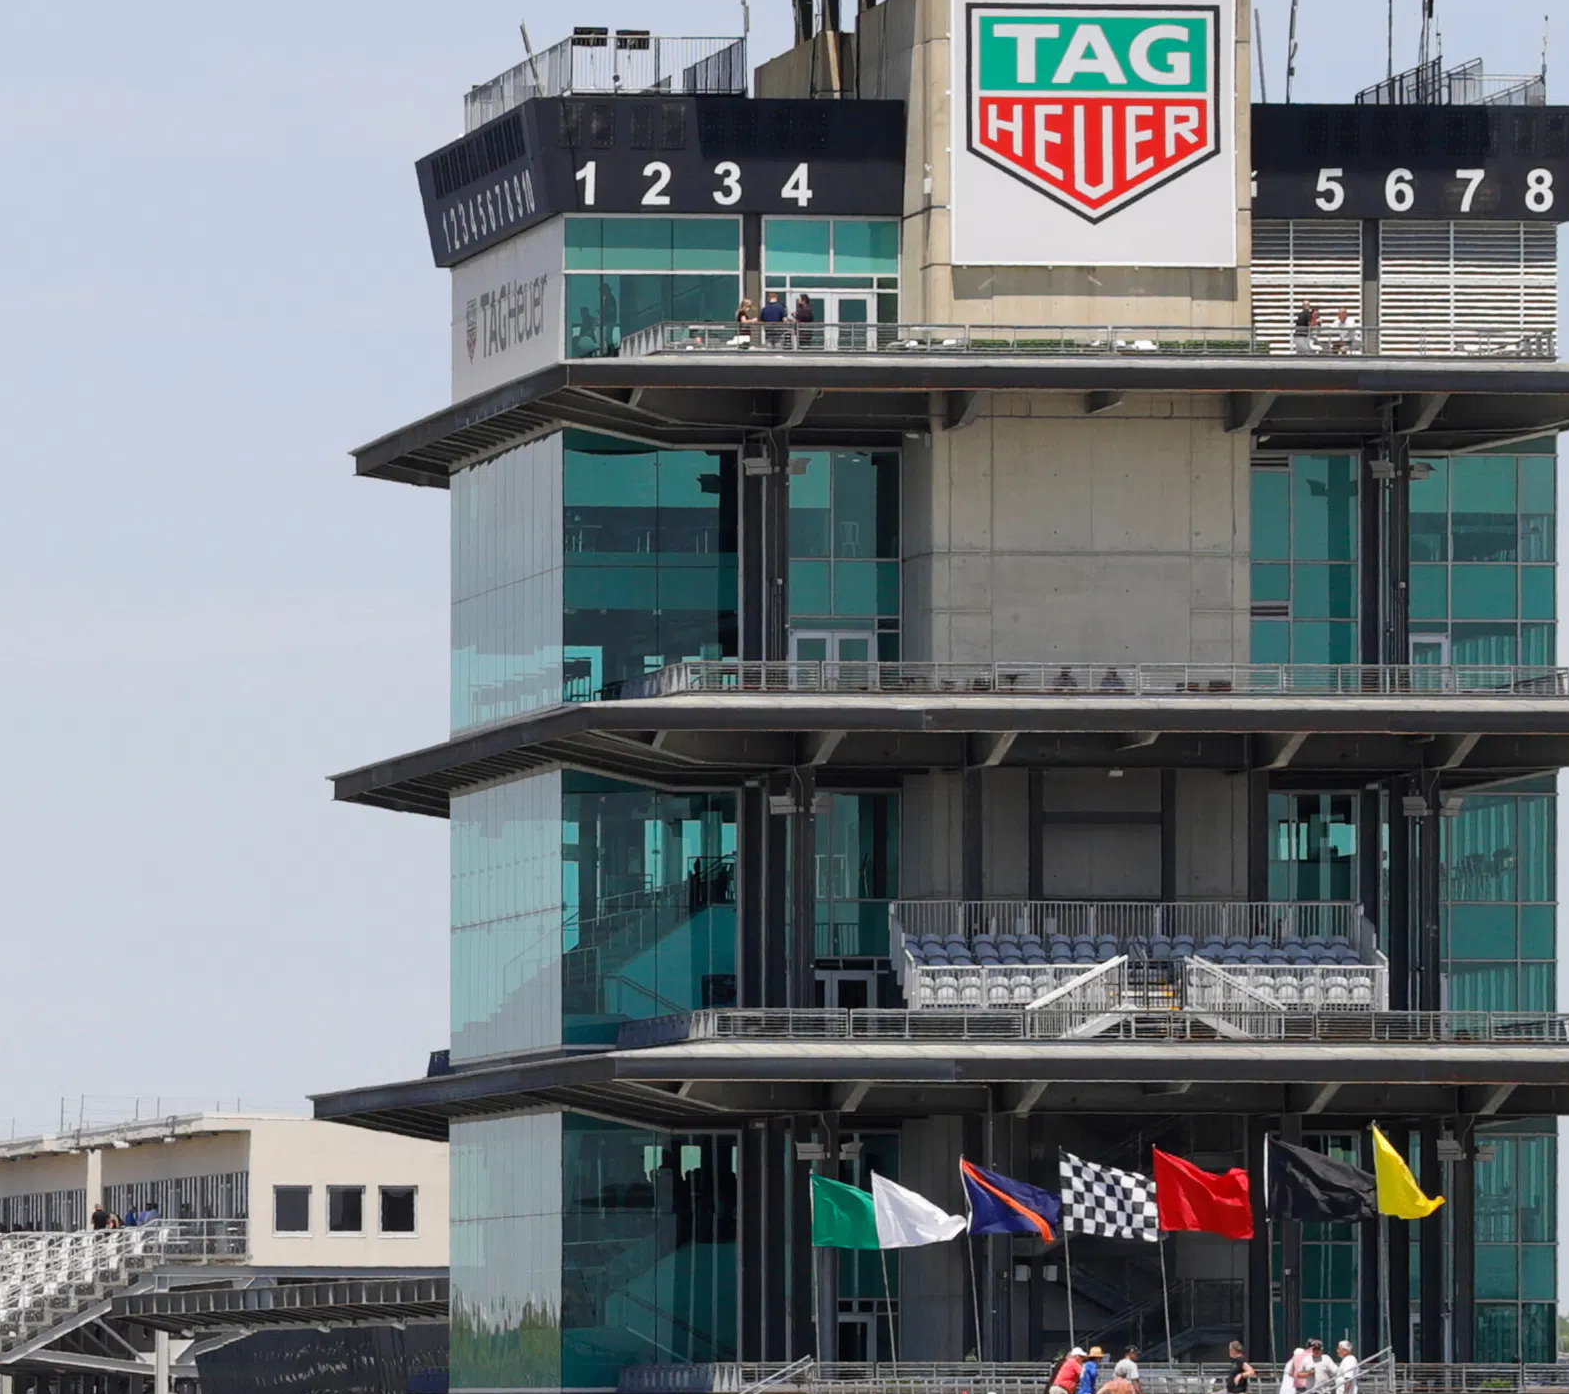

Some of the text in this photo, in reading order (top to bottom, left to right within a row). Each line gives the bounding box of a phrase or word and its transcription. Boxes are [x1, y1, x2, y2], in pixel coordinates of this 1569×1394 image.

[992, 23, 1191, 85] TAG
[987, 104, 1199, 200] HEUER
[442, 169, 535, 253] 1 2 3 4 5 6 7 8 9 10
[575, 160, 812, 207] 1 2 3 4
[1315, 167, 1554, 213] 5 6 7 8
